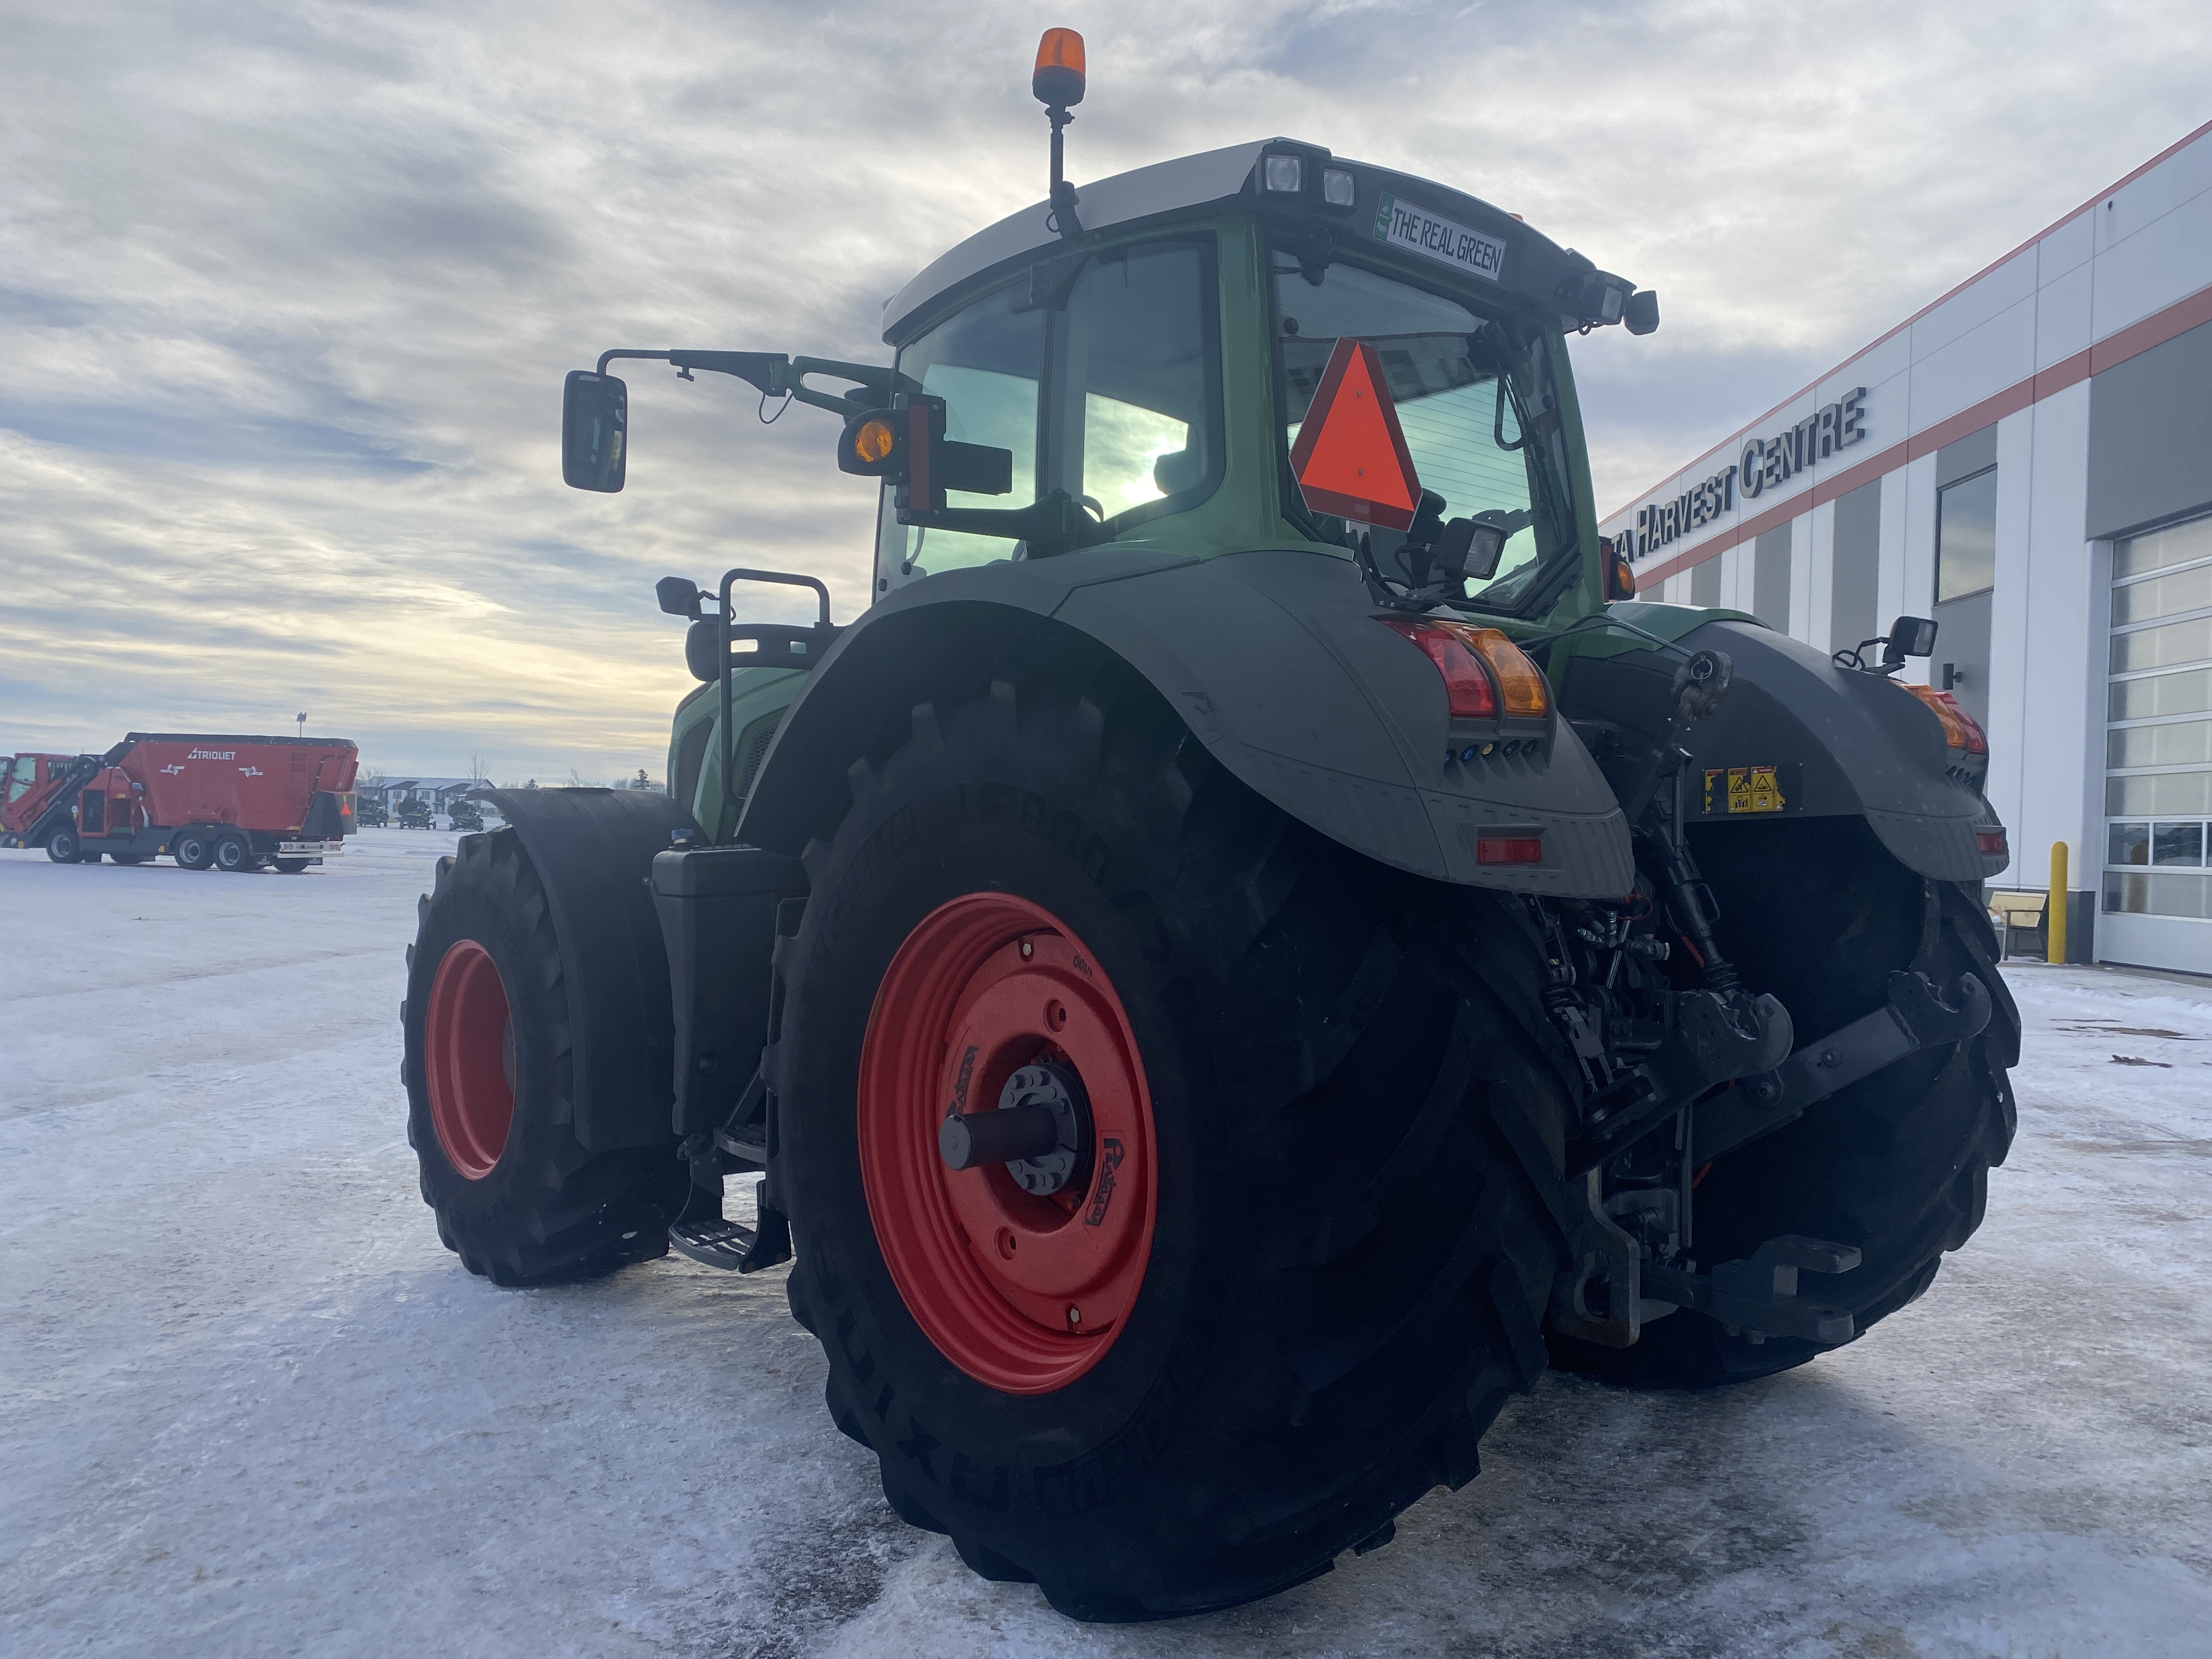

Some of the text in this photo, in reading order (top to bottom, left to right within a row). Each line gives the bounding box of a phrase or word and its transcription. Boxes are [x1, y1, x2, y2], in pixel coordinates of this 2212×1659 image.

[1392, 207, 1502, 273] THE REAL GREEN
[1635, 465, 1737, 558] HARVEST
[1739, 387, 1866, 499] CENTRE
[196, 751, 236, 760] TRIOLIET
